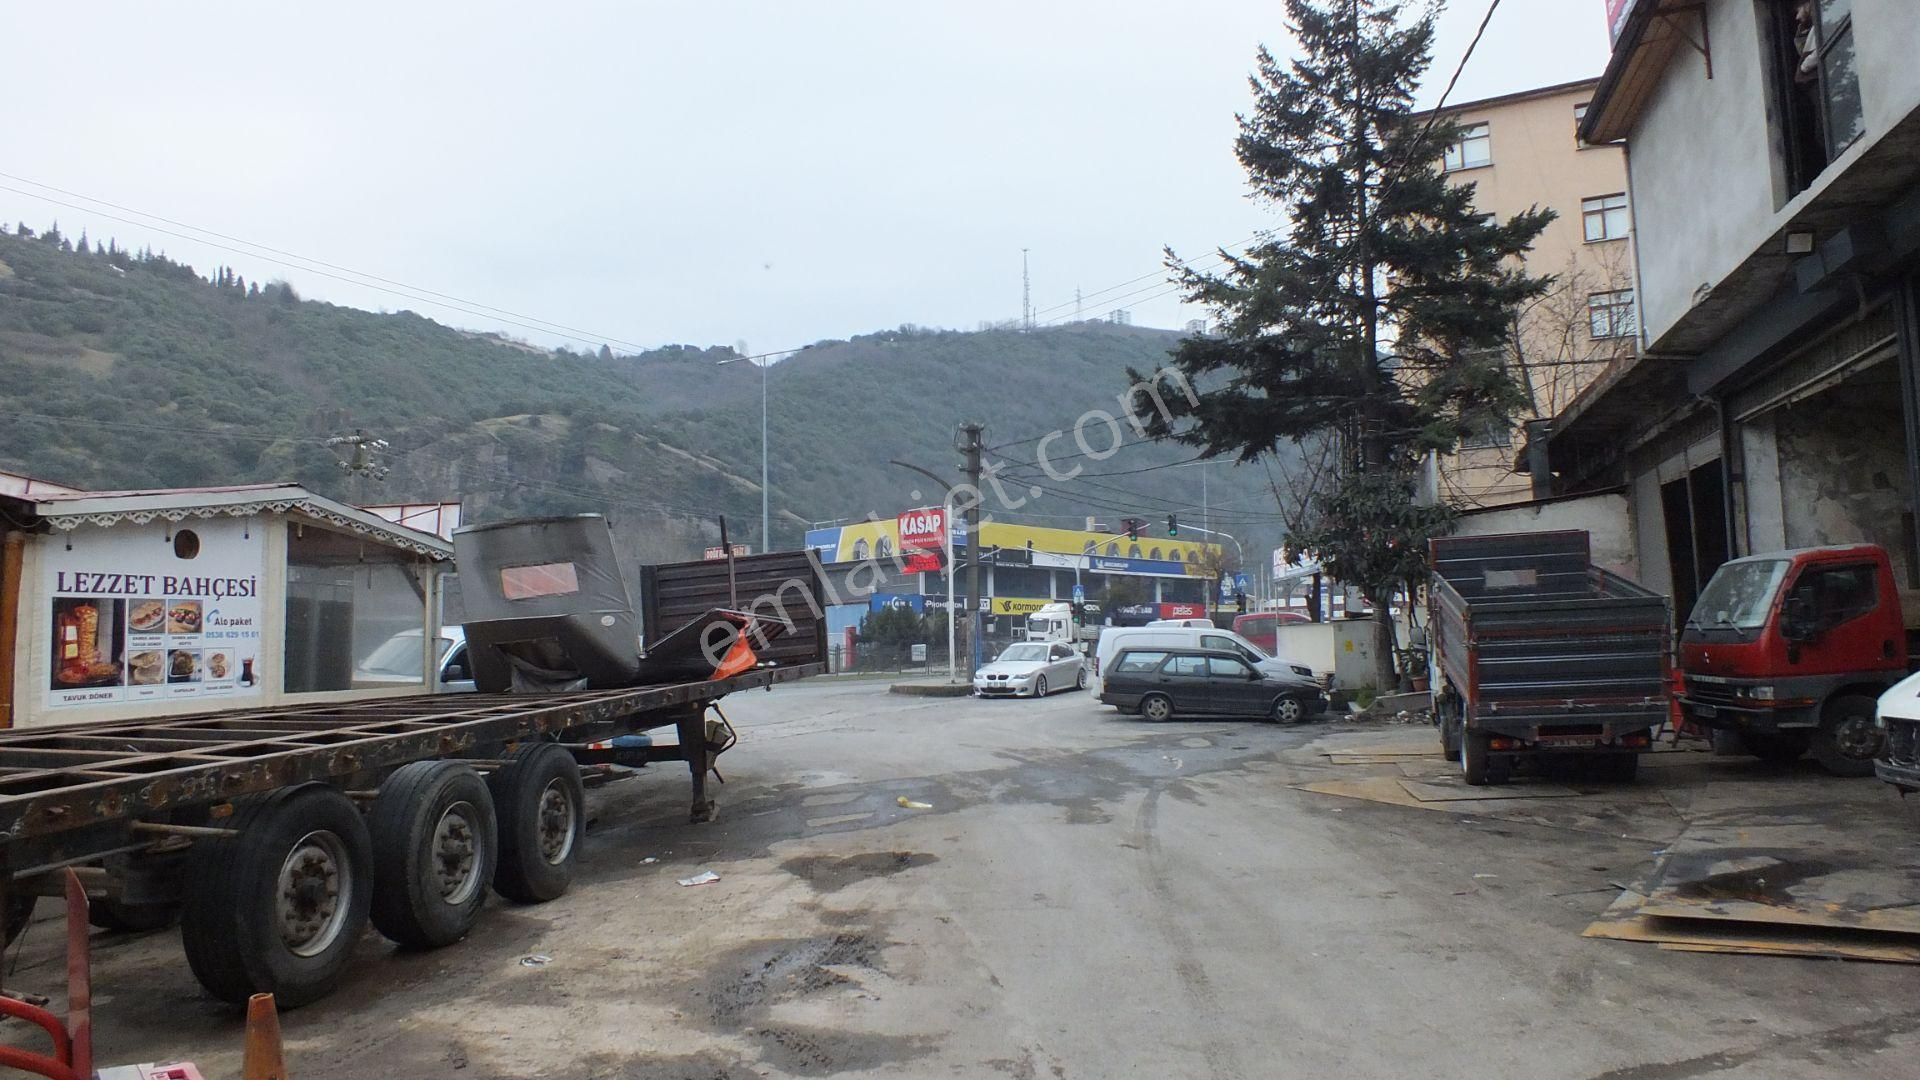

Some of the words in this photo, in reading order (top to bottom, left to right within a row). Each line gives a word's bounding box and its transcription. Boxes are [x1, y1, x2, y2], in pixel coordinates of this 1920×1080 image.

[900, 514, 941, 536] KASAP
[57, 571, 155, 594] LEZZET
[163, 575, 257, 601] BAHÇESİ
[214, 617, 229, 626] Alo
[230, 617, 252, 627] paket
[63, 694, 87, 702] TAVUK
